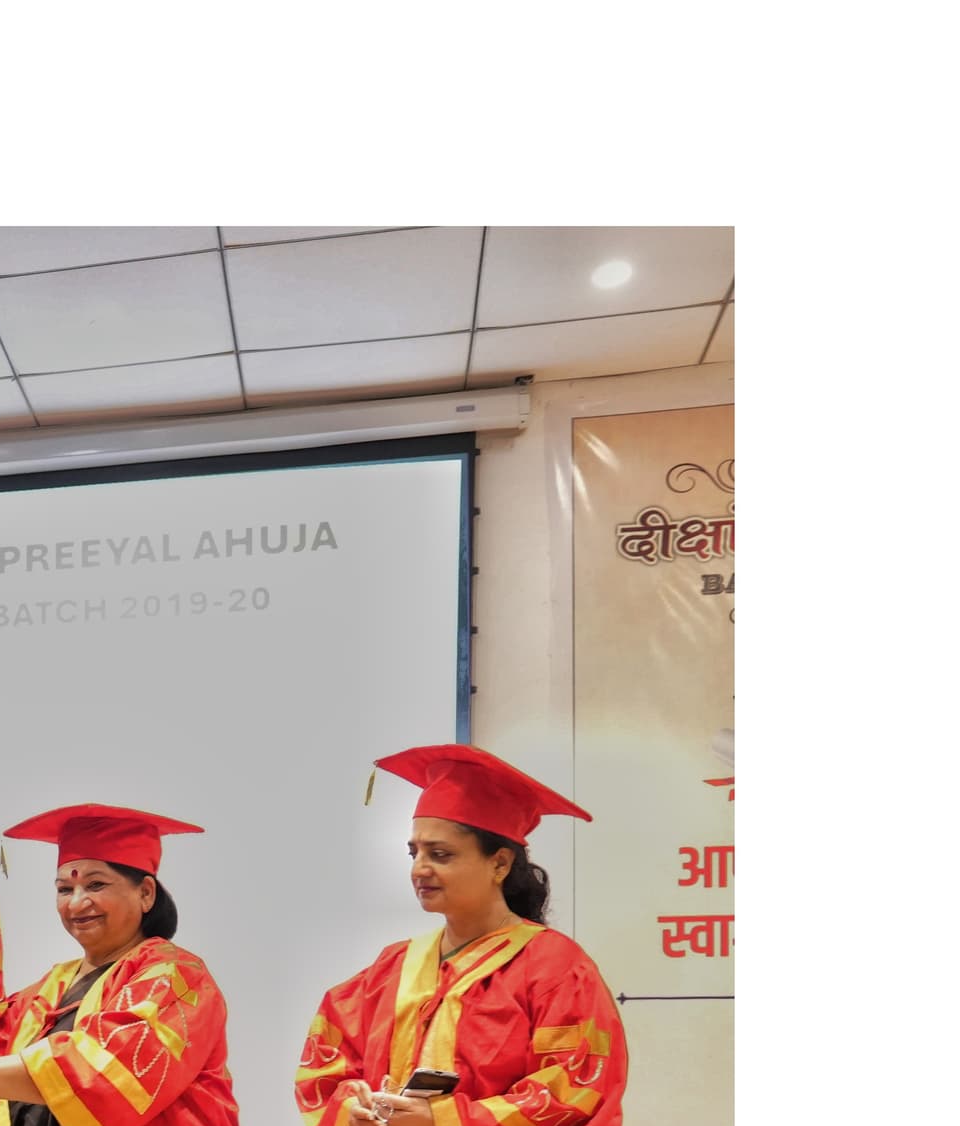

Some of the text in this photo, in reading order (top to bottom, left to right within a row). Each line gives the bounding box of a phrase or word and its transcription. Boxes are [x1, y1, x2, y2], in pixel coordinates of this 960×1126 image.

[192, 521, 339, 561] AHUJA
[119, 587, 271, 621] 2019-20
[678, 845, 734, 888] आ
[657, 915, 734, 958] स्वा
